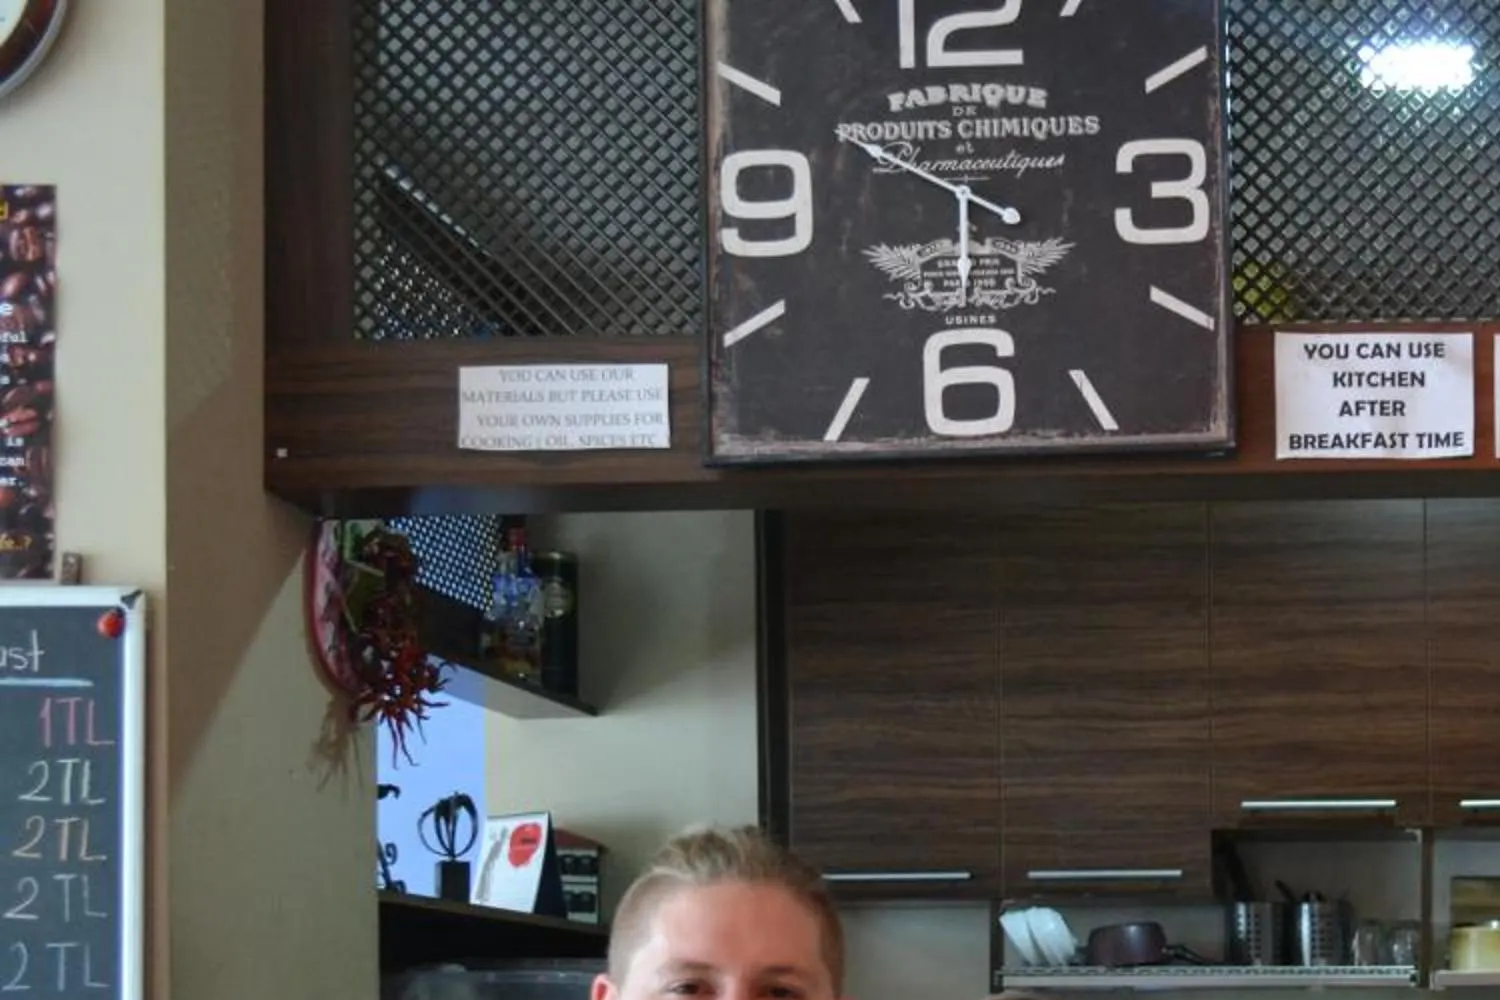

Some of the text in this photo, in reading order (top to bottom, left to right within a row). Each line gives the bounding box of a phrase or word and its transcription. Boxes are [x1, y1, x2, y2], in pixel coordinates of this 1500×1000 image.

[899, 0, 1024, 69] 12
[887, 82, 1049, 112] FABRIQUE
[952, 105, 978, 117] DE
[836, 115, 1101, 143] PRODUITS CHIMIQUES
[955, 141, 975, 155] et
[874, 140, 1066, 179] Pharmaceutiques
[1113, 138, 1210, 245] 3
[719, 149, 813, 257] 9
[945, 314, 997, 326] USINES
[1303, 341, 1446, 360] YOU CAN USE
[498, 367, 634, 384] YOU CAN USE OUR
[922, 328, 1016, 436] 6
[1332, 371, 1426, 389] KITCHEN
[461, 386, 663, 406] MATERIALS BUT PLEASE USE
[1338, 399, 1407, 418] AFTER
[476, 411, 663, 428] YOUR OWN SUPPLIES FOR
[1288, 431, 1466, 451] BREAKFAST TIME
